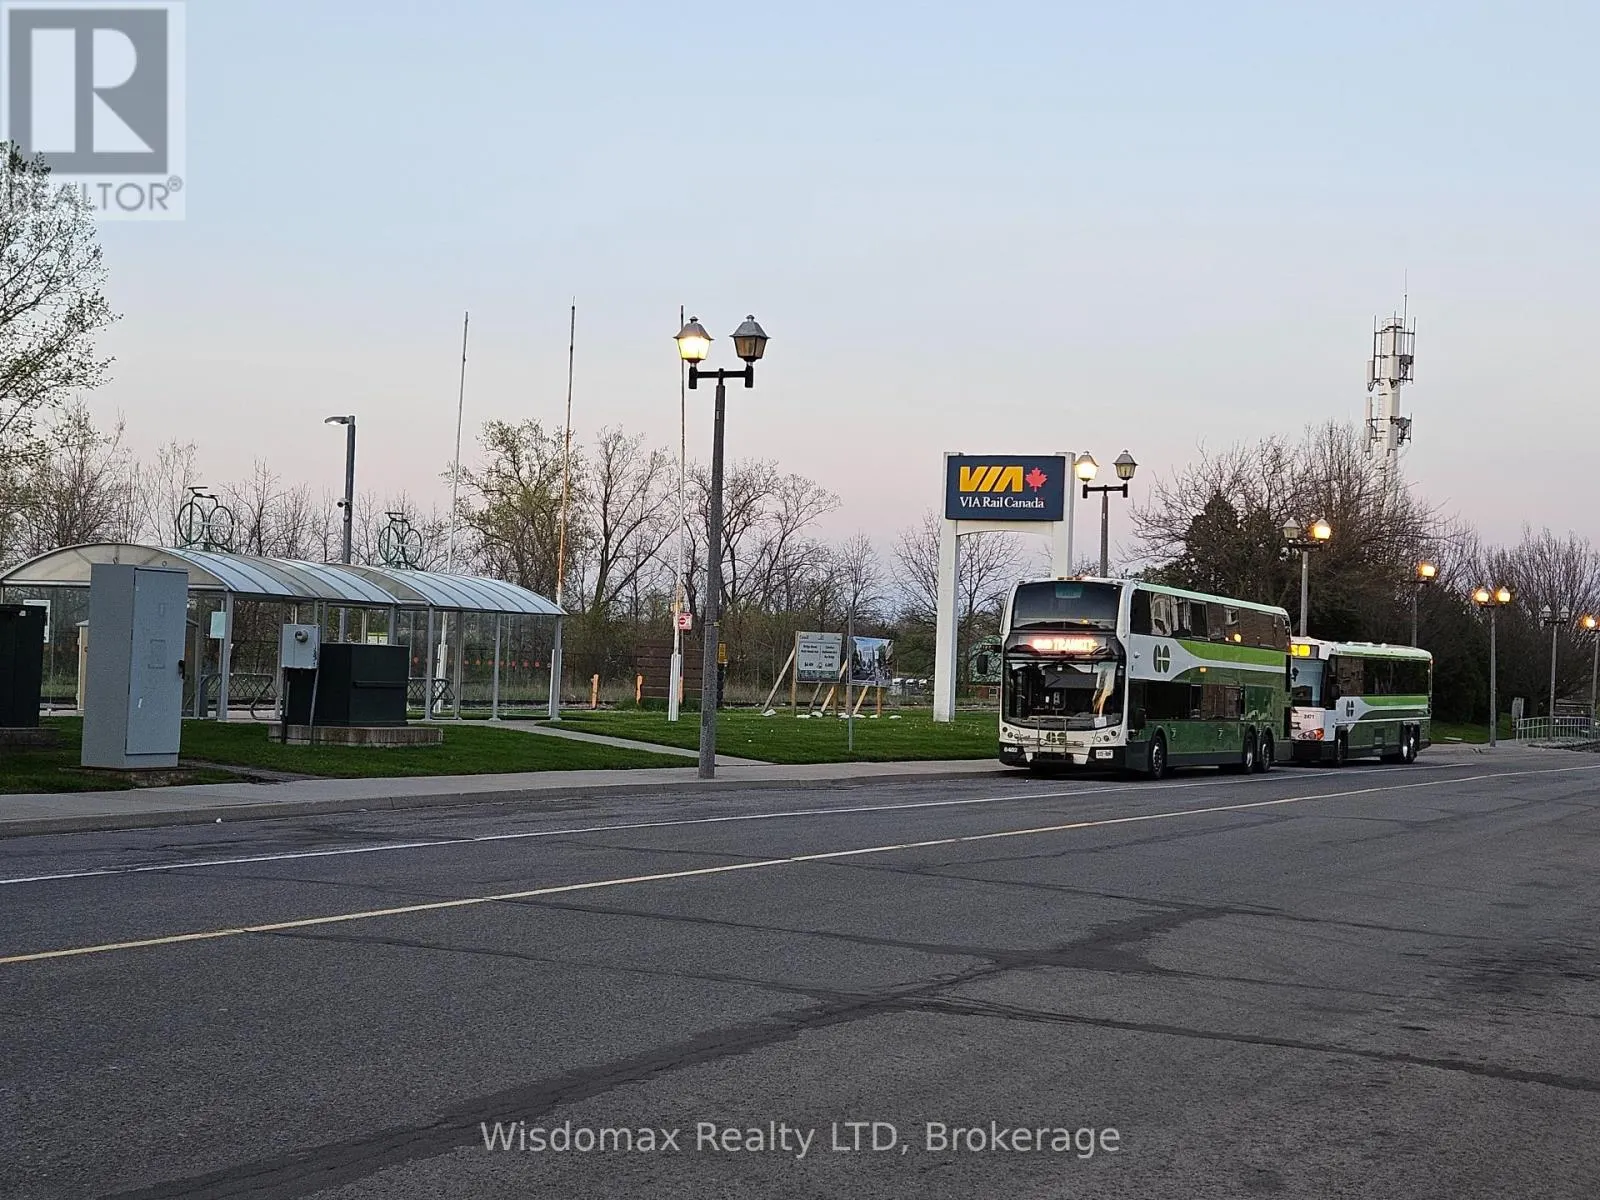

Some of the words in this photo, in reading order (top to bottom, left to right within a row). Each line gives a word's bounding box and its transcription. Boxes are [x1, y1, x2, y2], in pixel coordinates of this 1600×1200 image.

[960, 466, 1024, 492] VIA
[960, 496, 981, 508] VIA
[982, 496, 1003, 508] Rail
[1004, 496, 1045, 509] Canada
